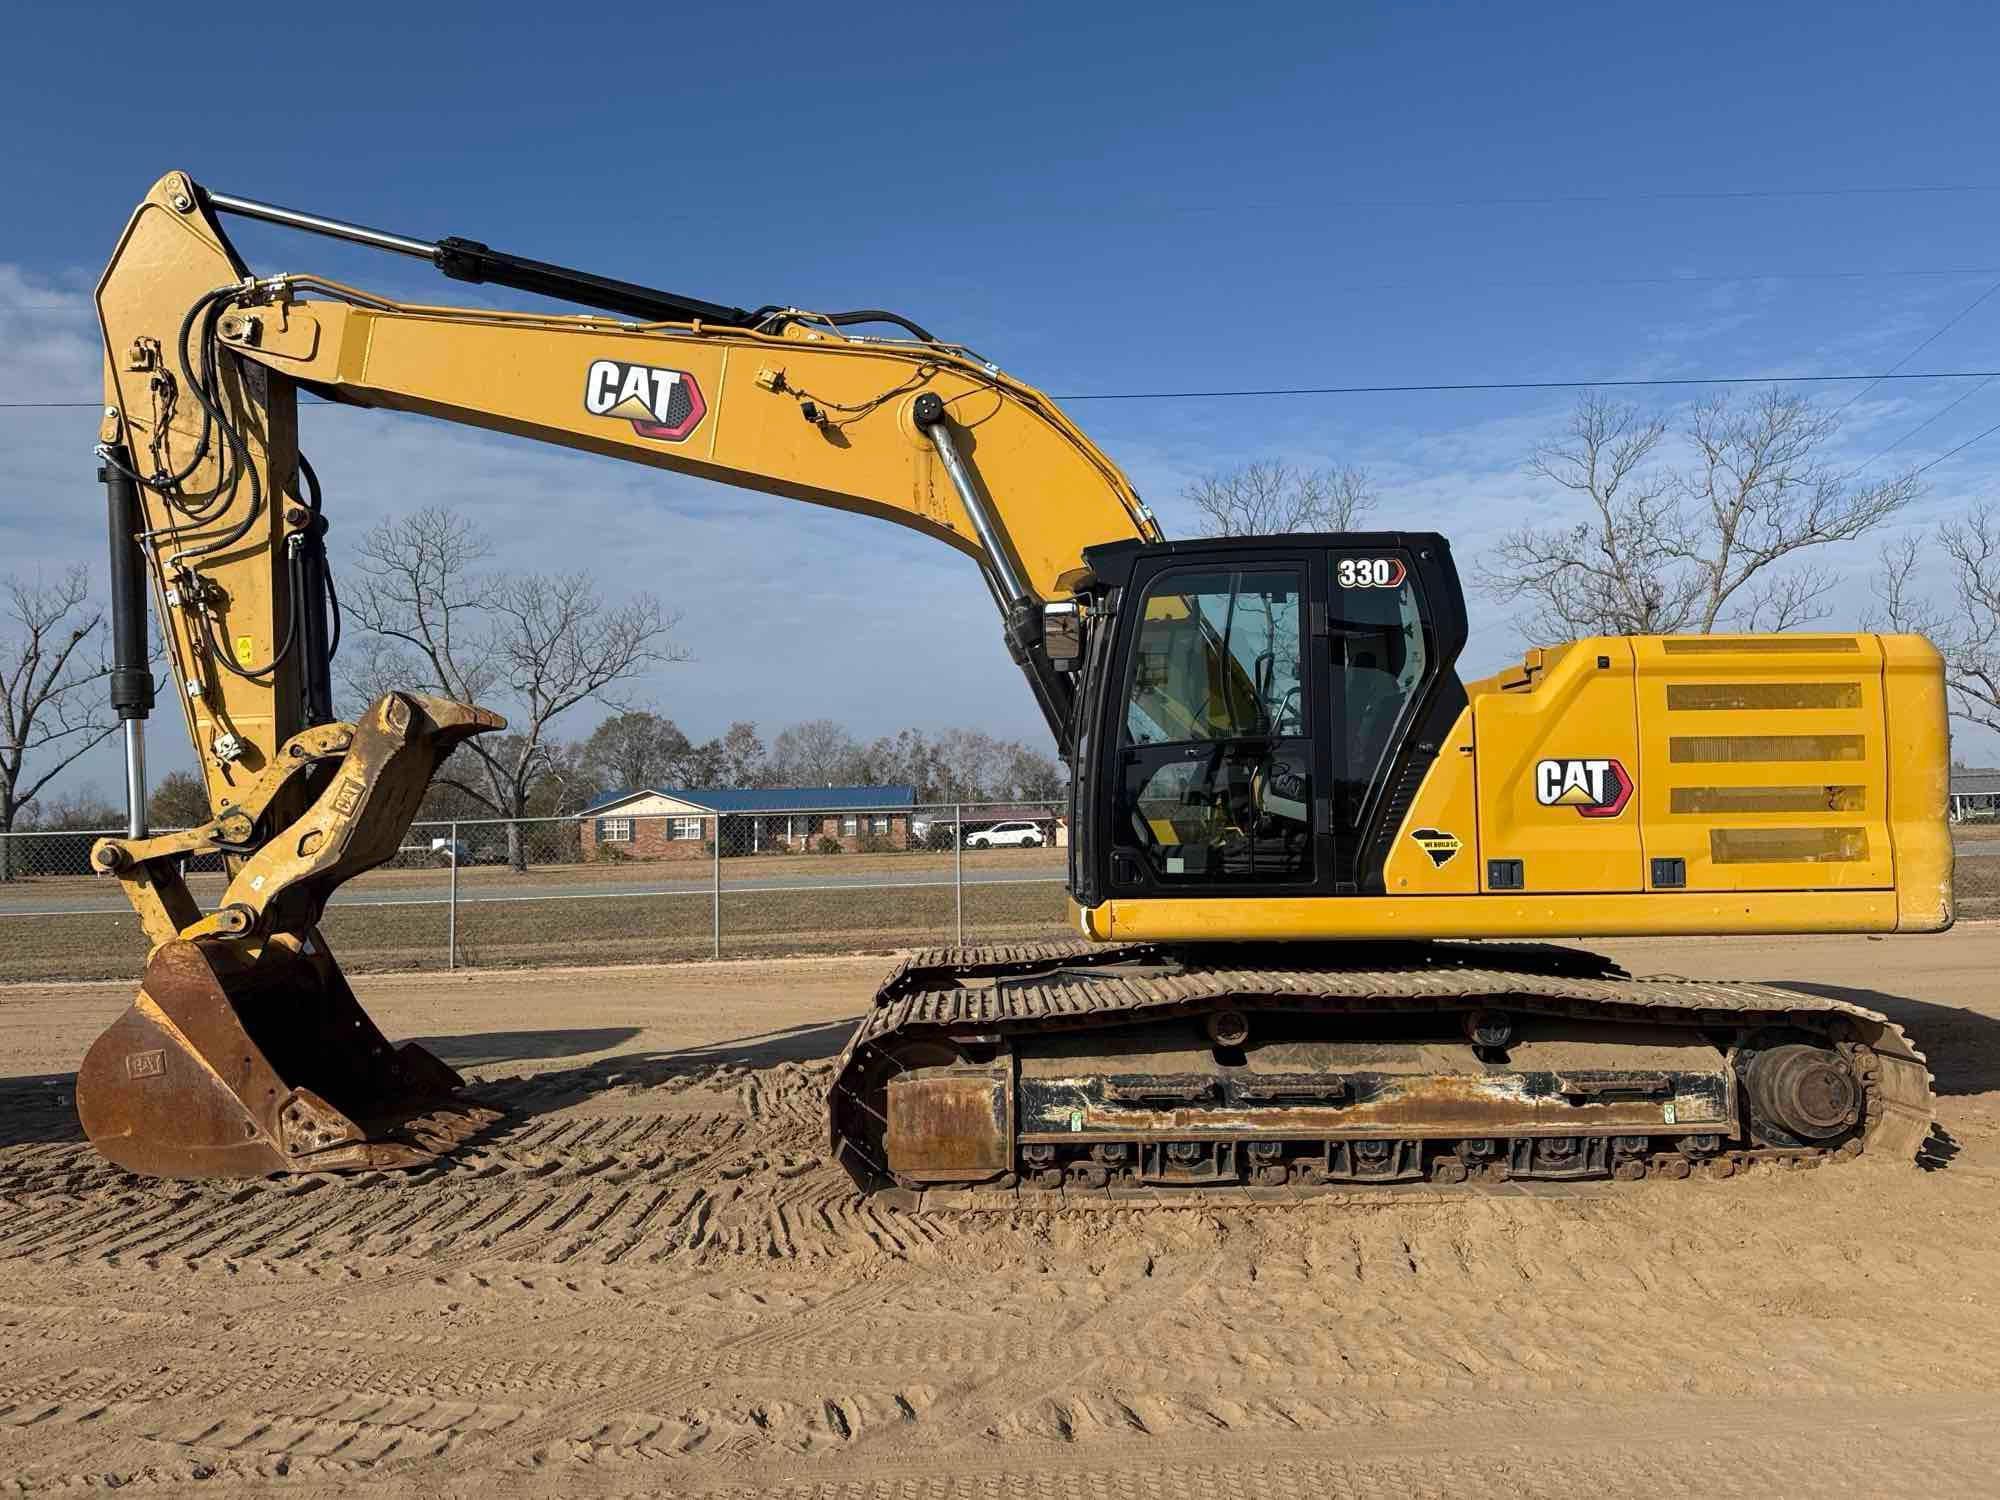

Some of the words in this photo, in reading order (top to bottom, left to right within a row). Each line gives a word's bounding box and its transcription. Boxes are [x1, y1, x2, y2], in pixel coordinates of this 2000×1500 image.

[586, 360, 681, 424] CAT
[1339, 559, 1389, 585] 330
[335, 782, 362, 812] CAT
[1537, 760, 1610, 805] CAT
[132, 1054, 161, 1074] CAT
